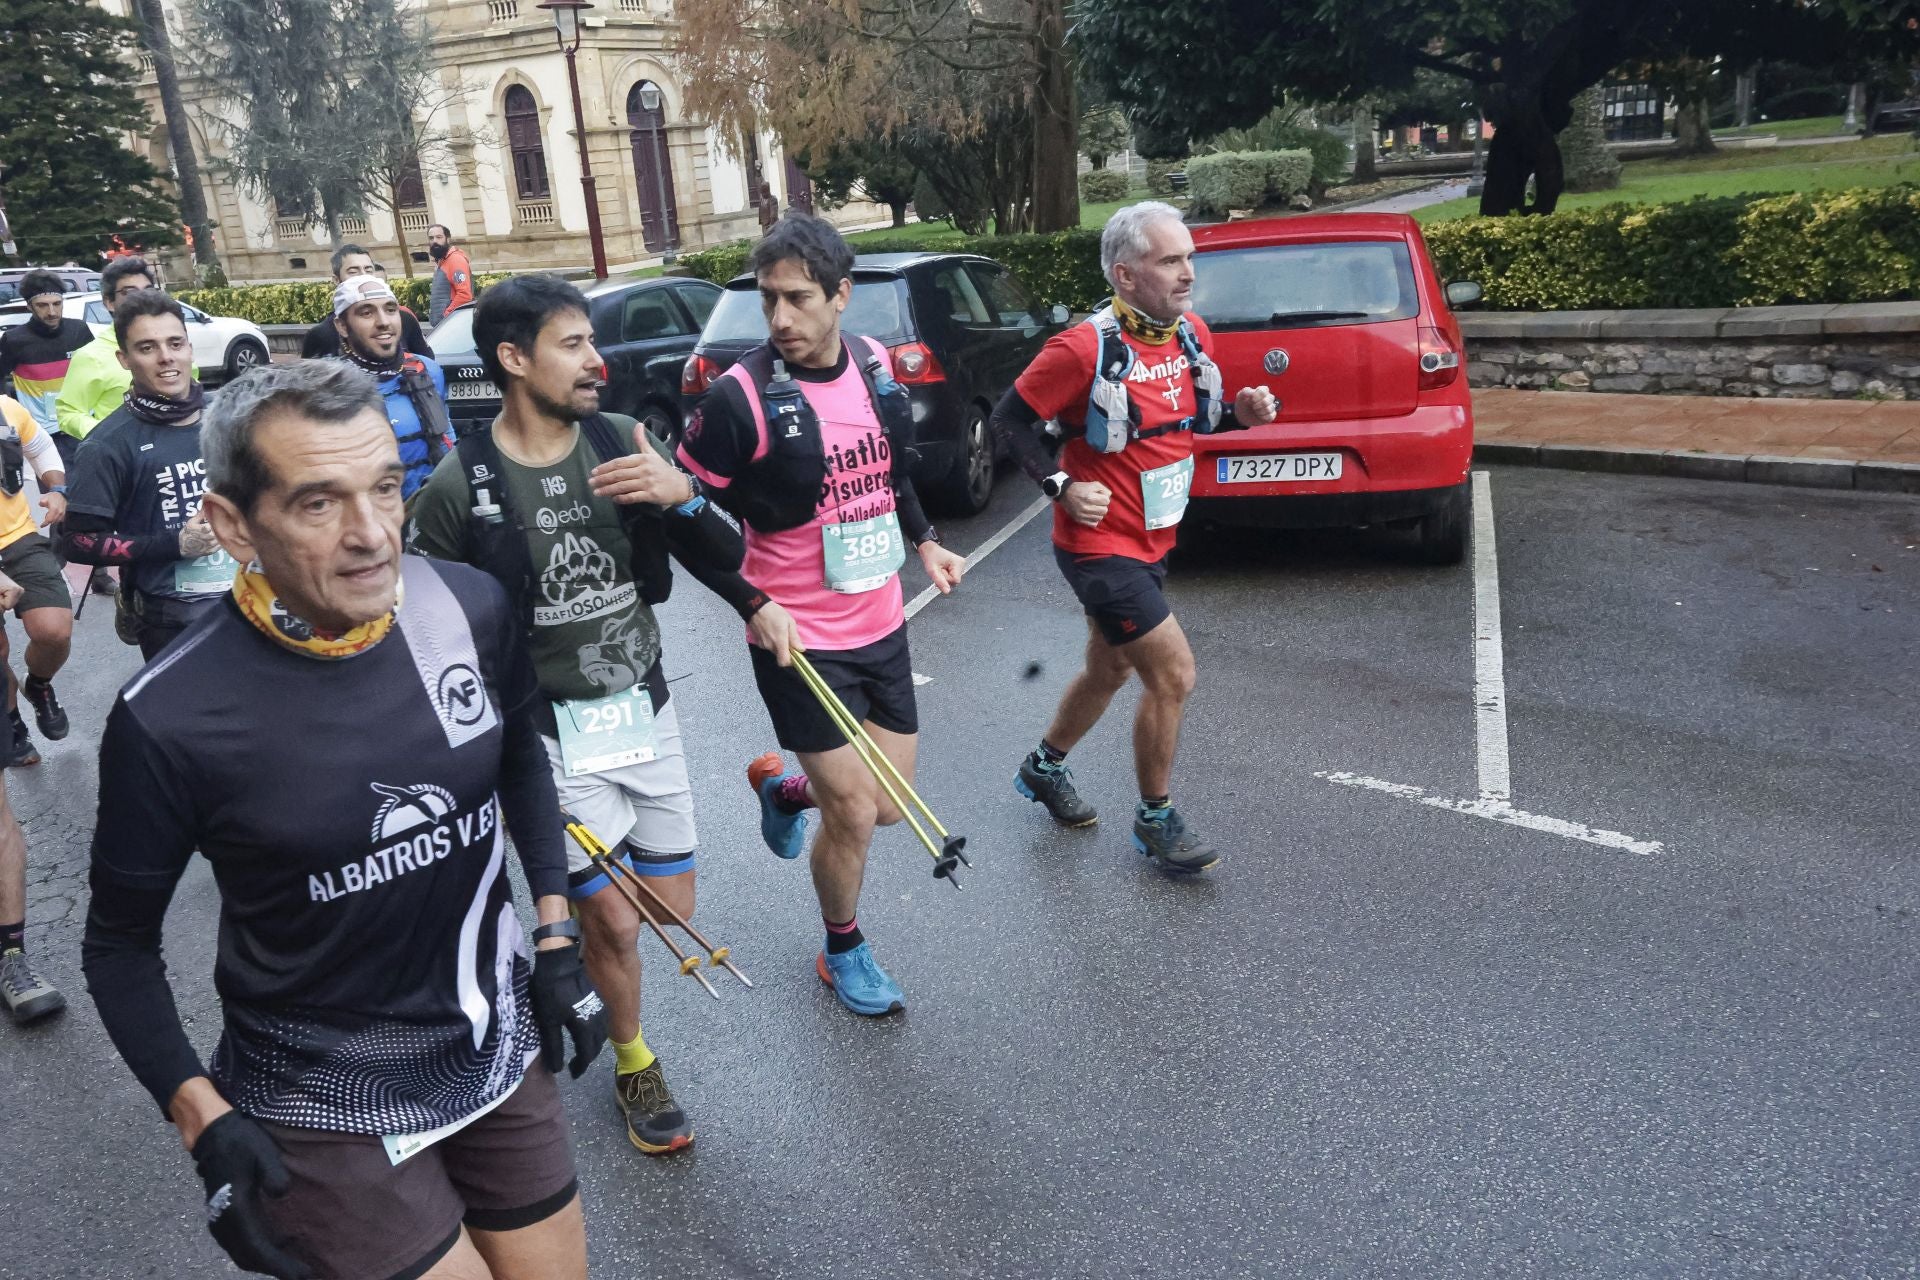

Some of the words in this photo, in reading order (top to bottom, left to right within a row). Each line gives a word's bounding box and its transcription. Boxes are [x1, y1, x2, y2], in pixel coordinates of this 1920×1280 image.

[451, 383, 480, 397] 9830
[1232, 458, 1286, 479] 7327
[1294, 457, 1335, 477] DPX
[156, 466, 180, 521] TRAIL
[1160, 470, 1189, 499] 281
[557, 500, 592, 525] edp
[839, 498, 891, 523] Valladolid
[842, 531, 890, 561] 389
[581, 701, 633, 733] 291
[308, 825, 451, 902] ALBATROS
